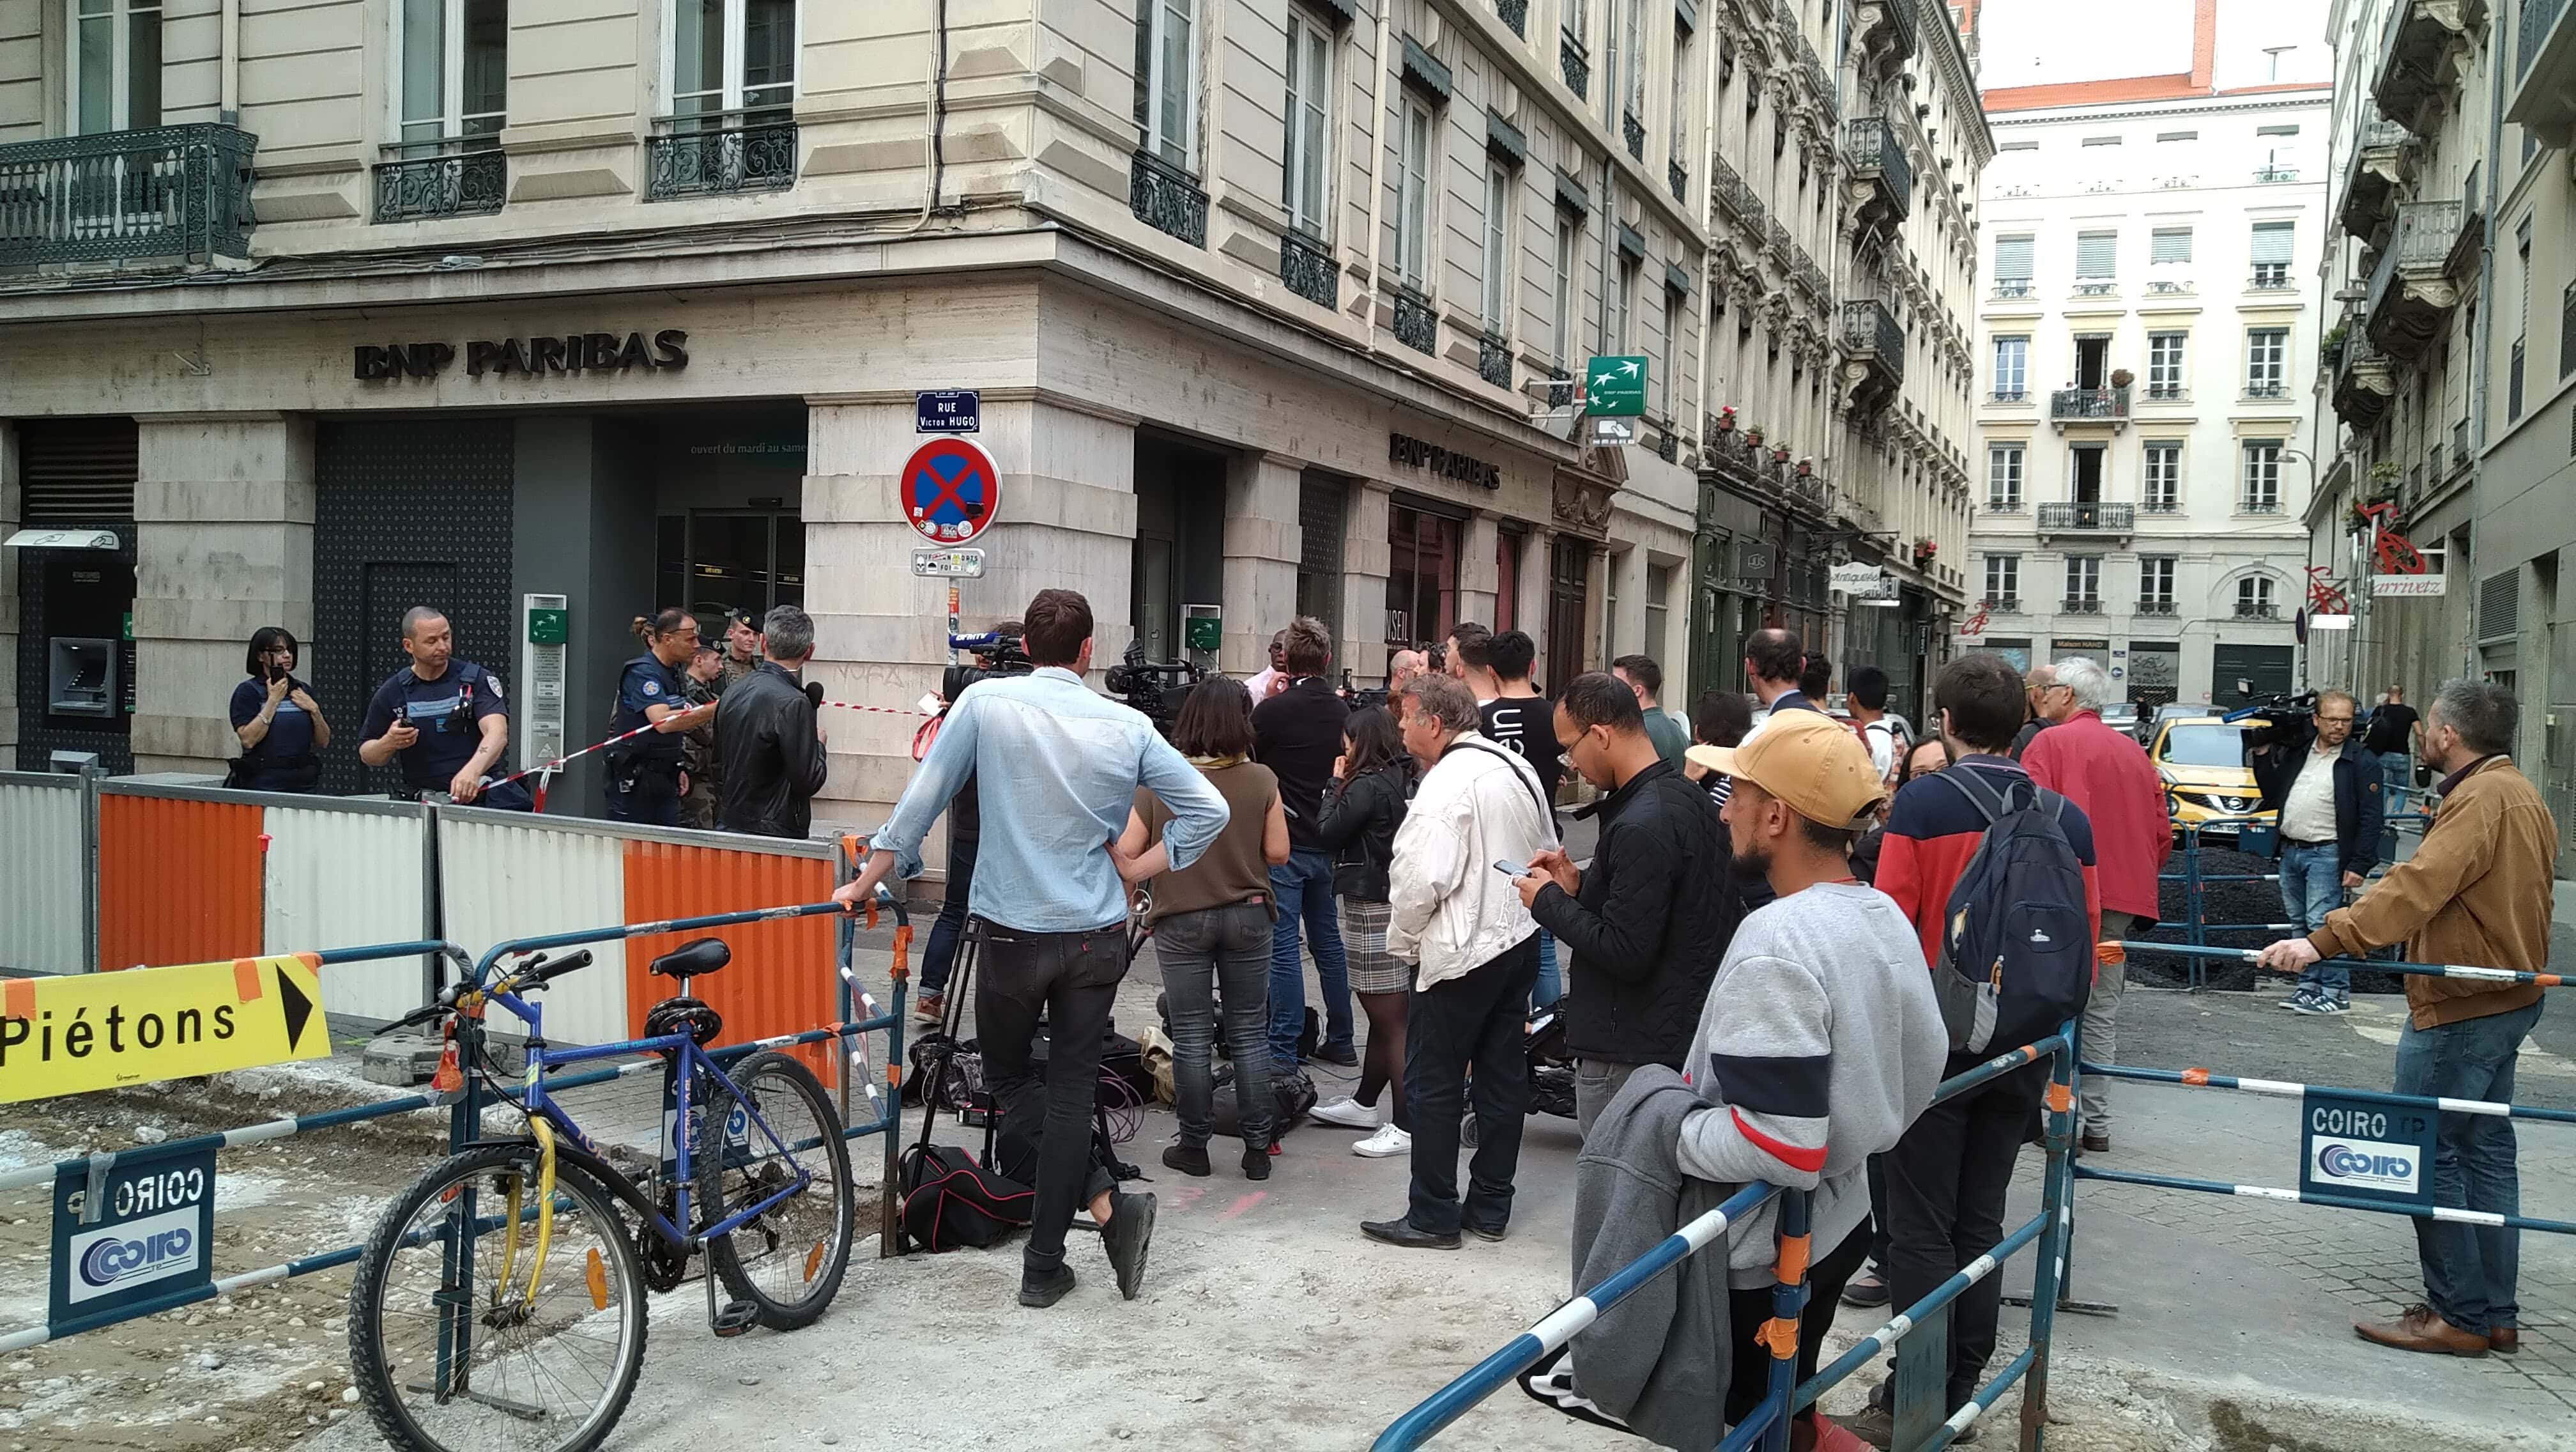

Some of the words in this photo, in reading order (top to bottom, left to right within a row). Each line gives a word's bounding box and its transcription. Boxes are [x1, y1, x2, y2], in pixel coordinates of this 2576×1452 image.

[354, 342, 454, 380] BNP
[466, 329, 689, 376] PARIBAS
[938, 403, 956, 413] RUE
[949, 416, 975, 426] HUGO
[691, 444, 721, 454] ouvert
[723, 443, 735, 453] du
[738, 442, 765, 453] mardi
[1390, 433, 1431, 467] BNP
[1430, 446, 1500, 490] PARIBAS
[2373, 576, 2440, 594] arrivetz
[0, 1005, 235, 1067] Piétons
[2312, 1107, 2388, 1138] COIRO
